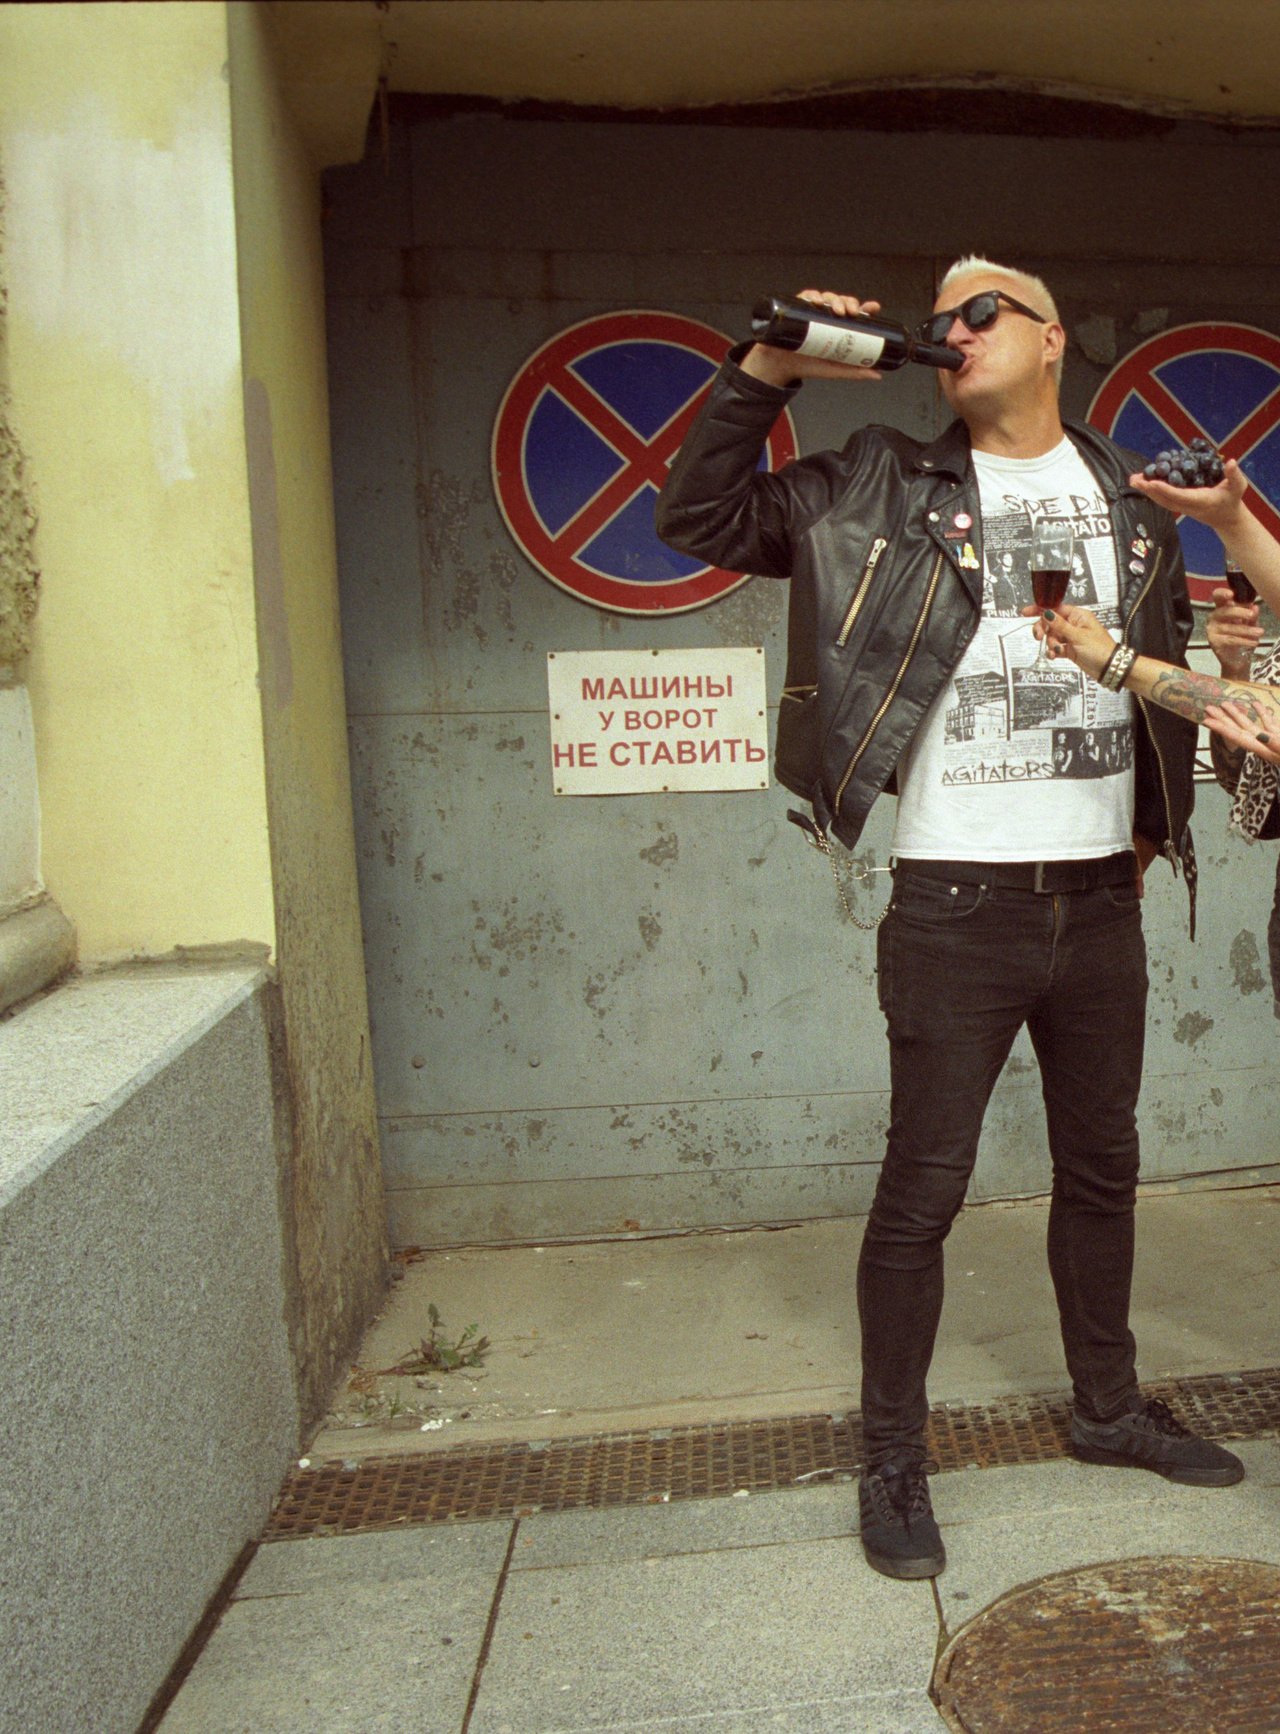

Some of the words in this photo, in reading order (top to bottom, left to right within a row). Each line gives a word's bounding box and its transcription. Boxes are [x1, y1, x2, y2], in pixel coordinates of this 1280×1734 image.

[986, 605, 1018, 618] PUNK
[582, 675, 733, 700] МАШИНЫ
[598, 711, 614, 731] У
[624, 708, 718, 730] ВОРОТ
[553, 743, 598, 767] НЕ
[609, 739, 766, 766] СТАВИТЬ
